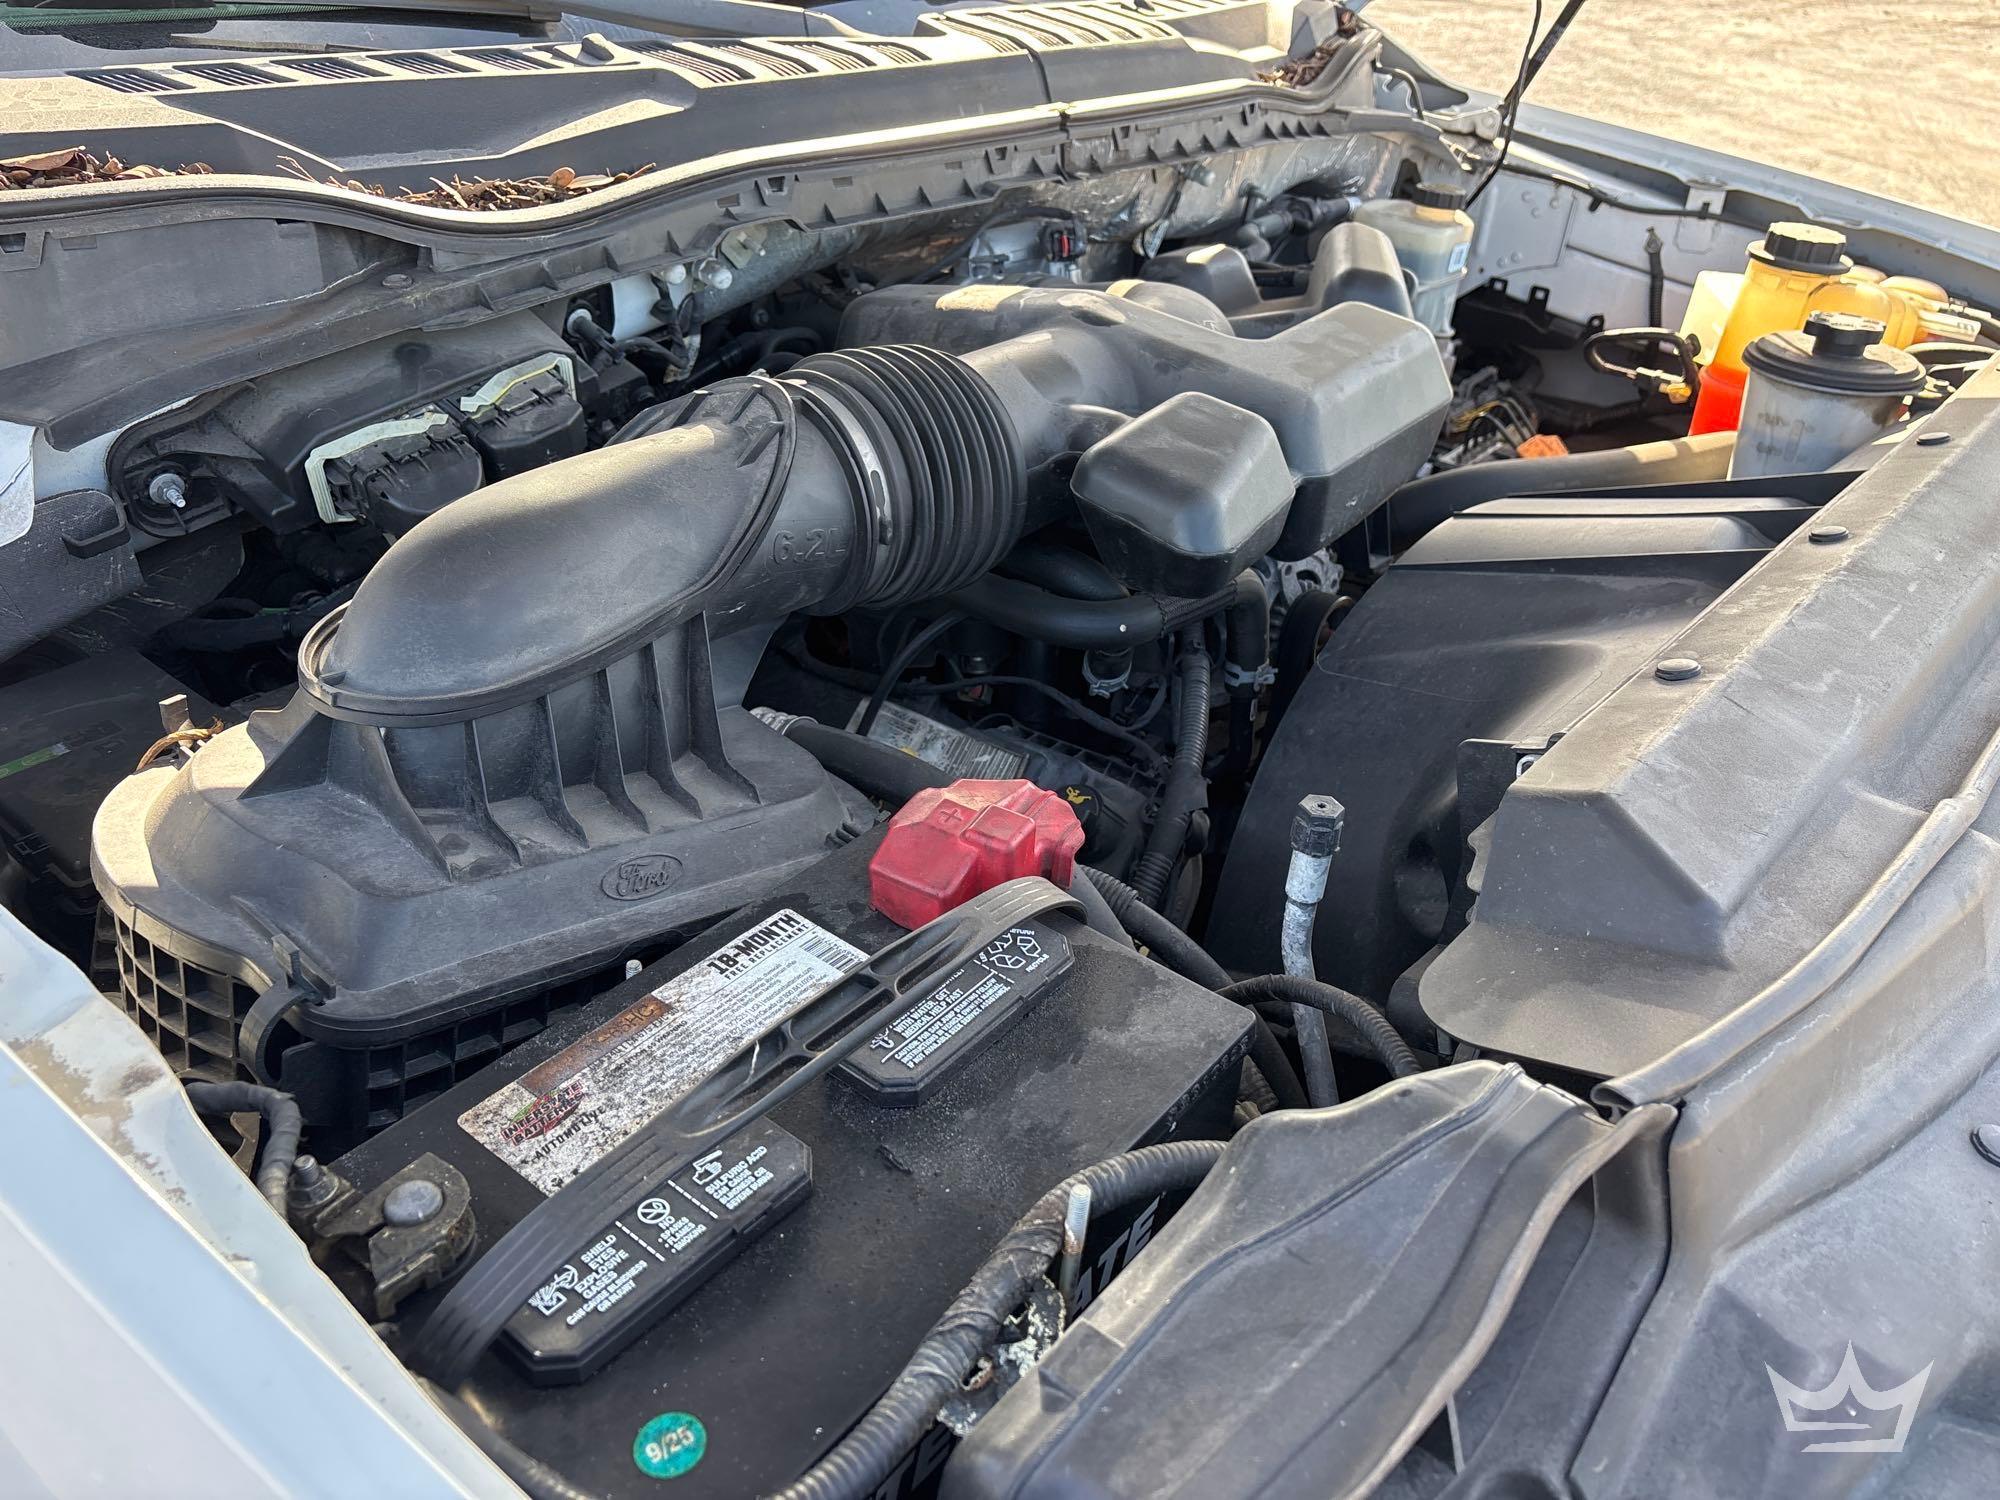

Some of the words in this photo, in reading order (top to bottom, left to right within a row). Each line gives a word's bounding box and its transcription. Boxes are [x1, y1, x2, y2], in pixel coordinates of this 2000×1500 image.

[772, 527, 846, 564] 6.2L
[616, 859, 671, 898] Ford
[706, 913, 802, 975] 18-MONTH
[724, 962, 749, 981] FREE
[748, 923, 810, 964] REPLACEMENT
[1025, 953, 1050, 973] RECYCLE
[893, 1017, 914, 1032] WITH
[935, 988, 950, 1001] GET
[901, 1013, 933, 1038] MEDICAL
[929, 1001, 947, 1016] HELP
[945, 988, 963, 1003] FAST
[917, 1031, 930, 1041] FOR
[953, 992, 978, 1013] STARTING
[975, 977, 996, 994] FOLLOW
[655, 1019, 688, 1042] WARNING
[900, 1033, 938, 1063] INSTRUCTIONS
[912, 1052, 925, 1063] NOT
[923, 1033, 951, 1055] AVAILABLE
[960, 1007, 982, 1025] SERVICE
[502, 1083, 582, 1140] INTERSTATE
[513, 1092, 586, 1145] BATTERIES
[533, 1105, 606, 1159] AUTOMOTIVE
[704, 1160, 748, 1194] SULFURIC
[745, 1144, 767, 1164] ACID
[712, 1185, 729, 1199] CAN
[727, 1168, 752, 1187] CAUSE
[718, 1175, 756, 1204] BLINDNESS
[753, 1166, 767, 1177] OR
[725, 1187, 753, 1209] SEVERE
[750, 1170, 774, 1190] BURNS
[657, 1214, 676, 1230] NO
[659, 1215, 689, 1240] SPARKS
[666, 1221, 696, 1245] FLAMES
[673, 1223, 707, 1251] SMOKING
[580, 1233, 617, 1263] SHIELD
[588, 1245, 616, 1270] EYES
[573, 1248, 629, 1293] EXPLOSIVE
[581, 1269, 618, 1299] GASES
[565, 1307, 586, 1326] CAN
[582, 1288, 610, 1312] CAUSE
[607, 1259, 648, 1292] BLINDNESS
[596, 1298, 612, 1312] OR
[608, 1279, 636, 1303] INJURY
[645, 1424, 695, 1465] 9/25
